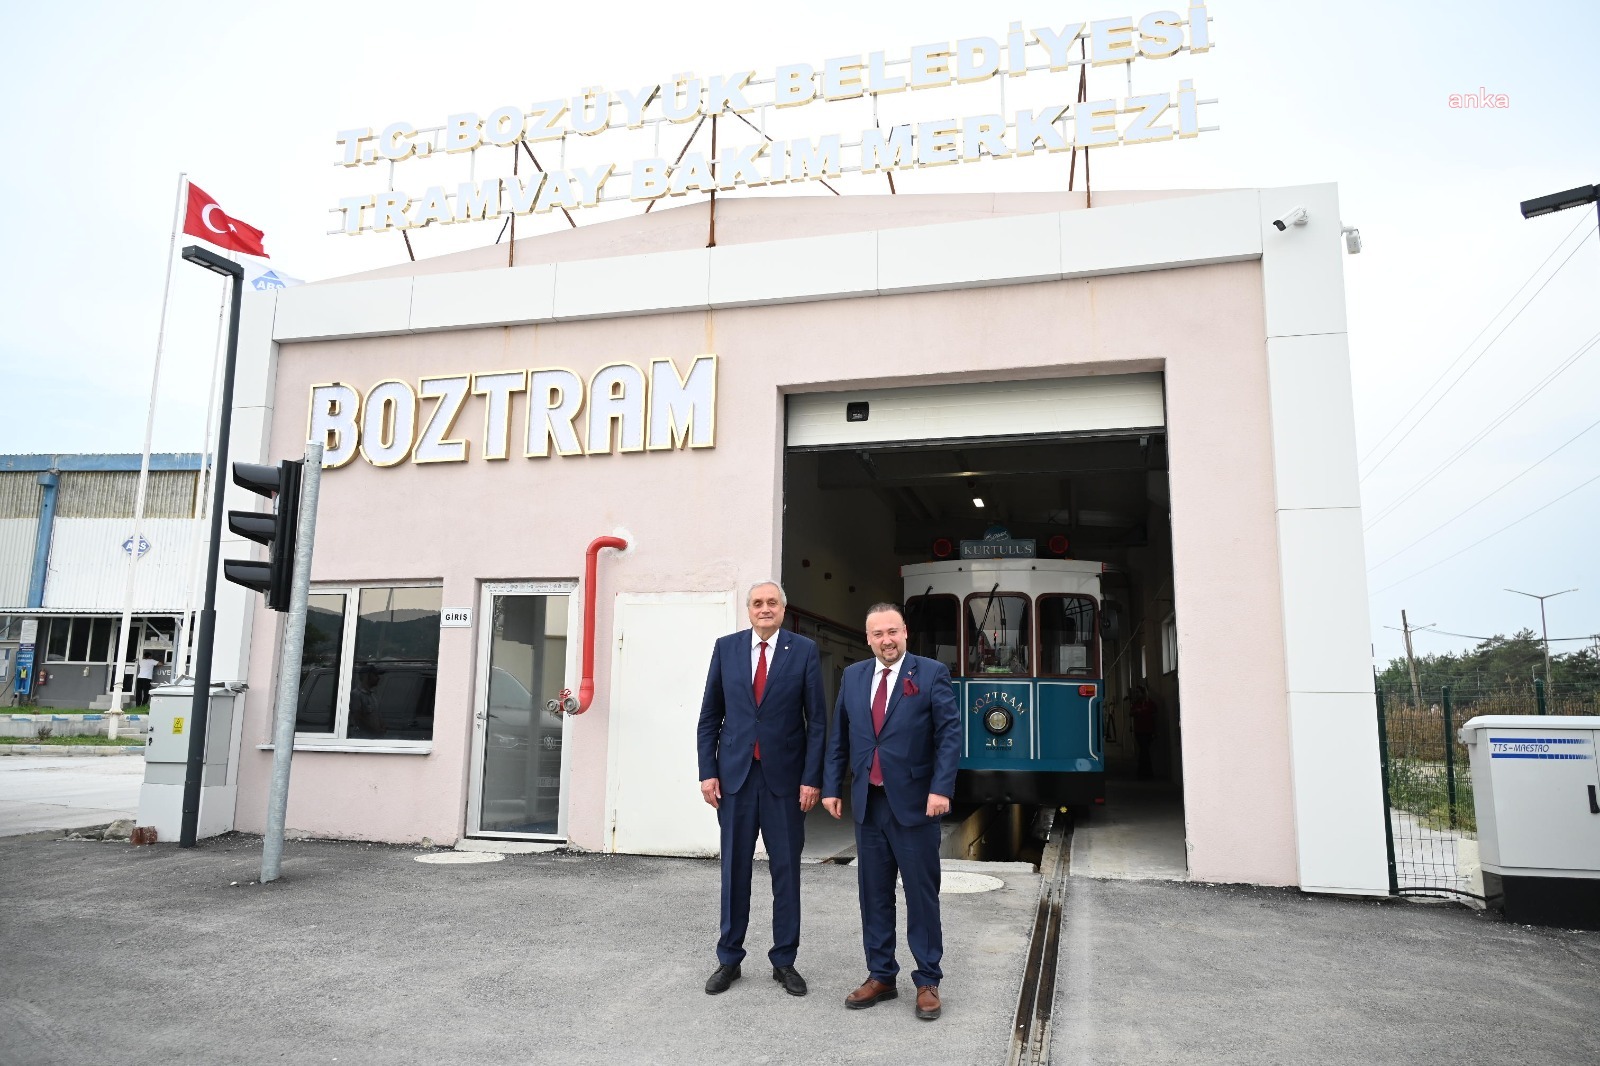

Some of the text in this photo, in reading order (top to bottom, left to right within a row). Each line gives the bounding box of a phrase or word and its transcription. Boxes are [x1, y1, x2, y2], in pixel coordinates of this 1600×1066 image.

[336, 0, 1210, 168] T.C. BOZÜYÜK BELEDİYESİ
[339, 79, 1199, 236] TRAMVAY BAKIM MERKEZİ
[306, 353, 720, 469] BOZTRAM
[126, 542, 147, 550] AS
[445, 612, 468, 622] GİRİŞ
[1493, 743, 1550, 753] TTS-MAESTRO
